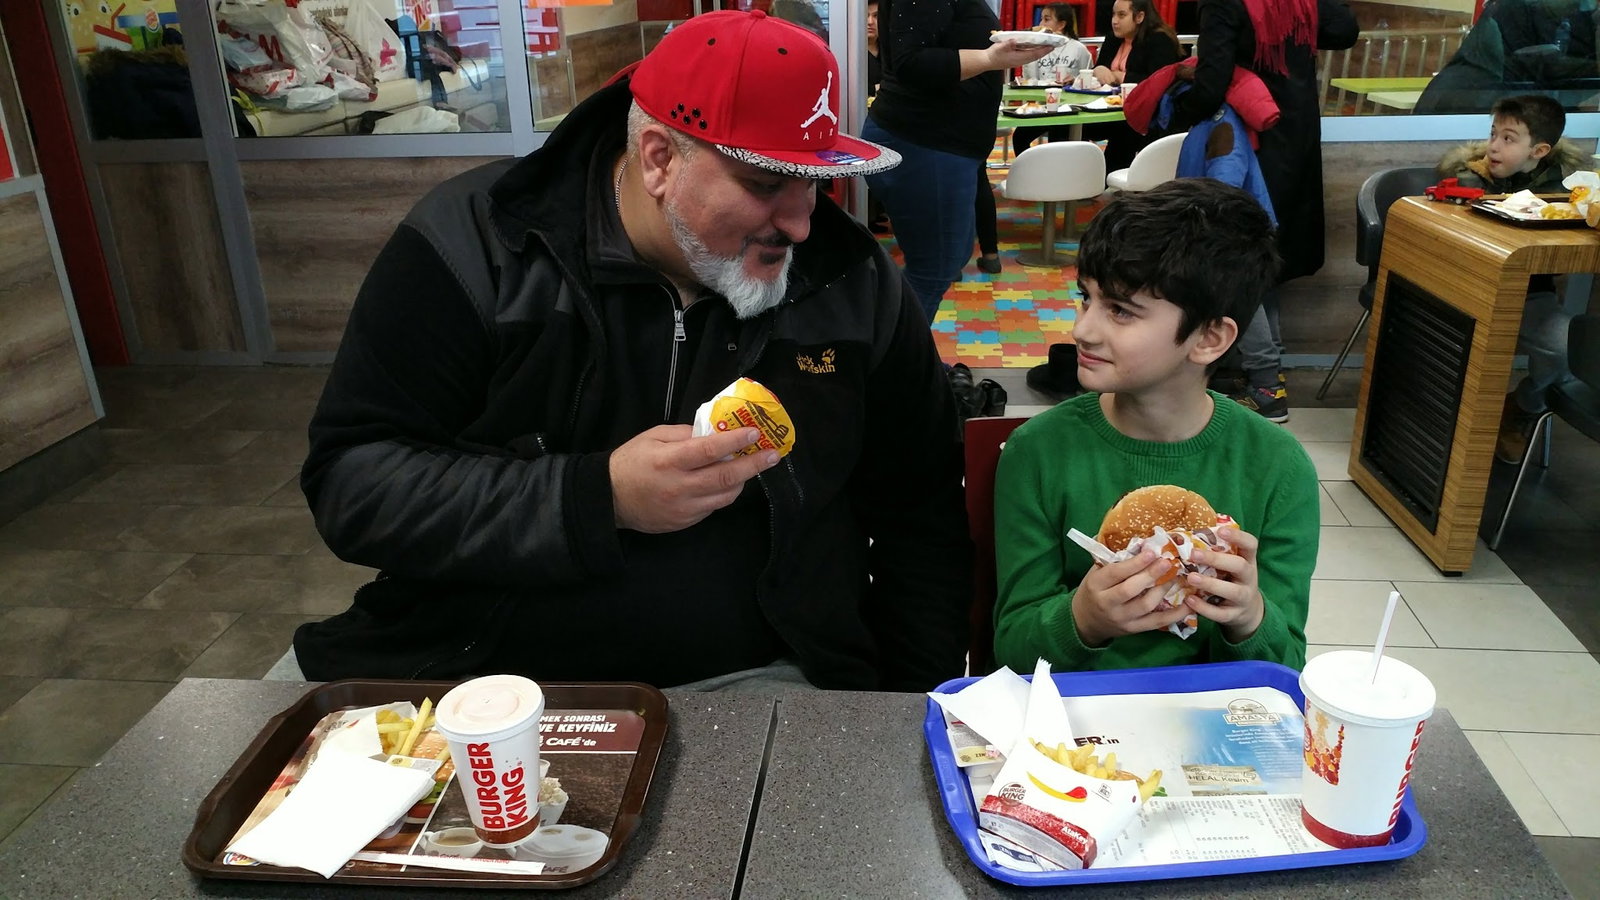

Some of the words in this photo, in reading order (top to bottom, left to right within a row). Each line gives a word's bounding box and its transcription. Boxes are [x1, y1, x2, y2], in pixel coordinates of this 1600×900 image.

[557, 722, 618, 733] KEYFİNİZ
[467, 742, 506, 829] BURGER
[501, 766, 529, 828] KING
[1000, 792, 1026, 801] KING
